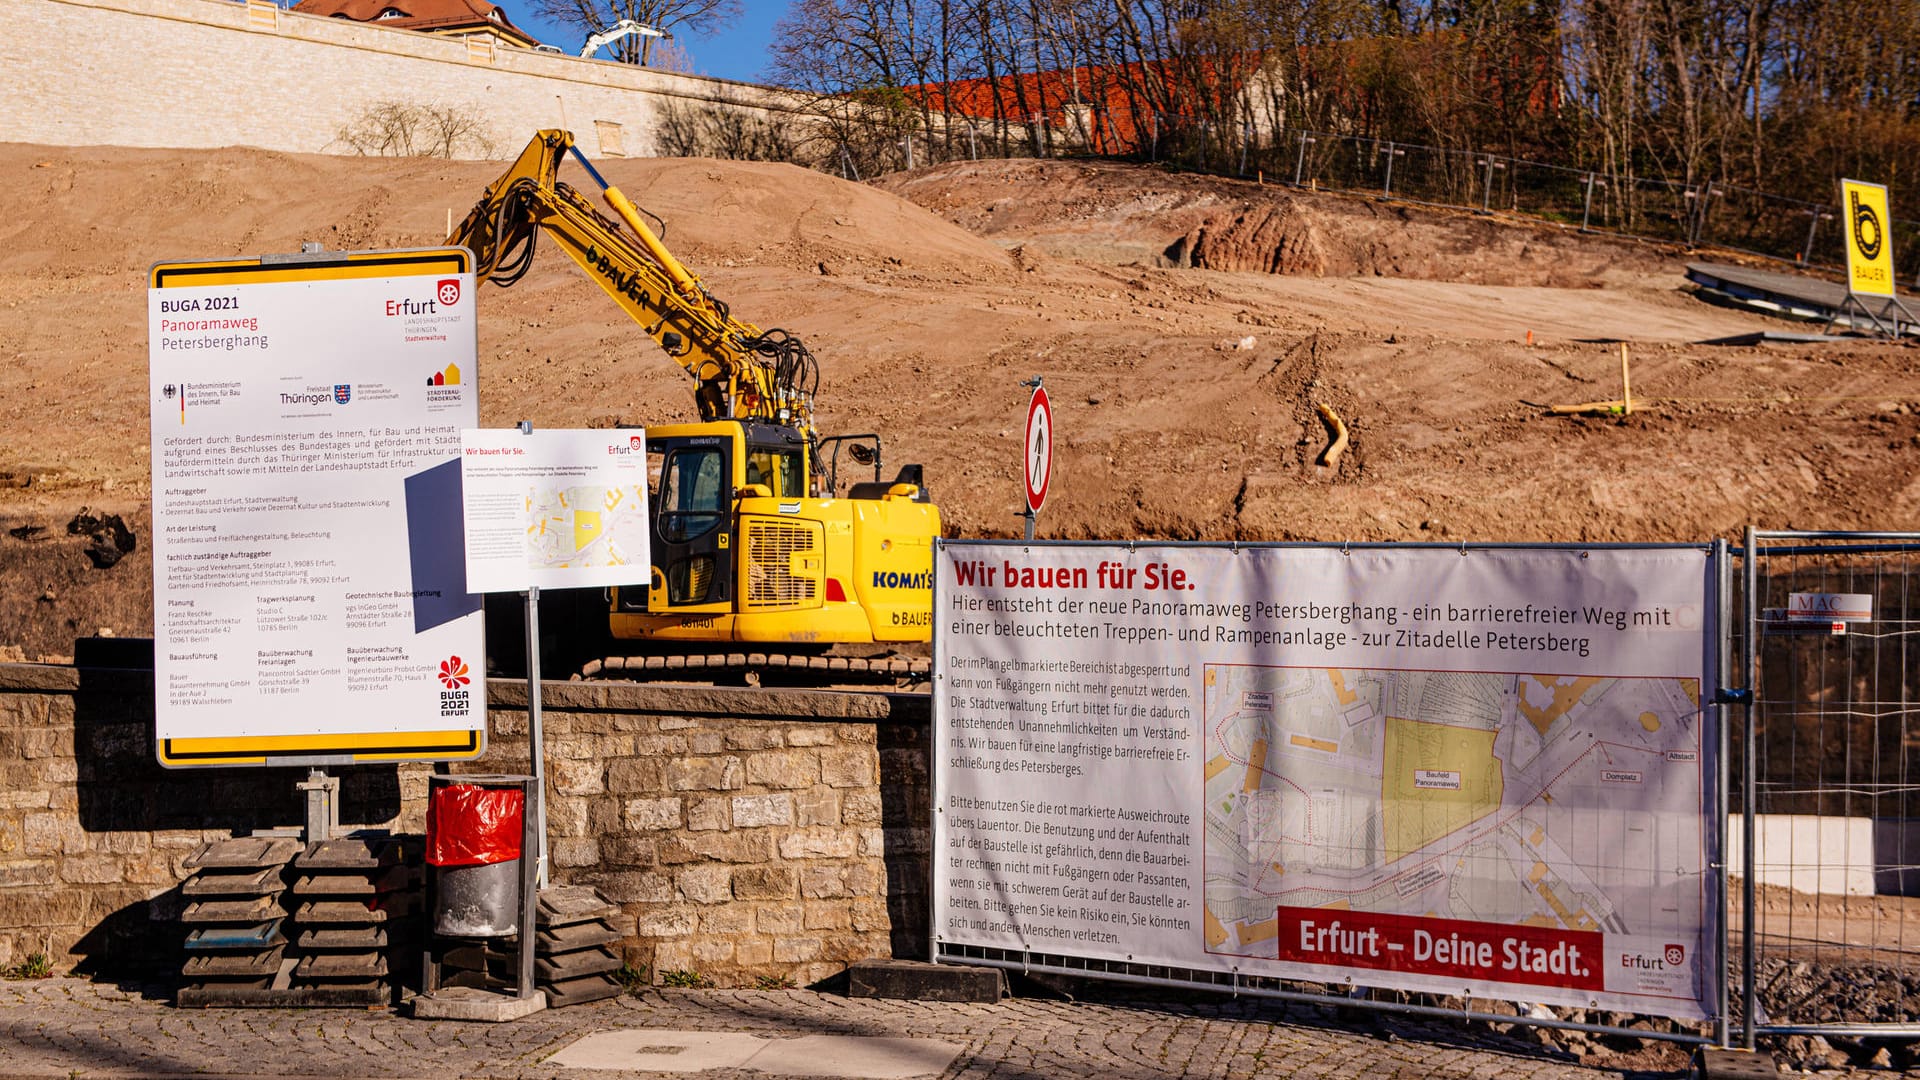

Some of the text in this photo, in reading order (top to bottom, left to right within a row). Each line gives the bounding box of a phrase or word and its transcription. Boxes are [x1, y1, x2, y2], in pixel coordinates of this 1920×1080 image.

[1855, 265, 1885, 281] BAUER
[597, 255, 650, 311] BAUER
[161, 296, 239, 313] BUGA 2021
[386, 298, 436, 316] Erfurt
[162, 318, 258, 332] Panoramaweg
[162, 334, 268, 351] Petersberghang
[405, 334, 446, 342] Stadtverwaltung
[187, 382, 241, 390] Bundesministerium
[280, 393, 331, 405] Thüringen
[164, 425, 455, 446] Gefördert durch: Bundesministerium des Innern, für Bau und Heimat
[501, 447, 511, 455] für
[608, 445, 630, 455] Erfurt
[165, 459, 416, 478] Landwirtschaft sowie mit Mitteln der Landeshauptstadt Erfurt.
[165, 488, 207, 496] Auftraggeber
[189, 525, 216, 533] Leistung
[873, 569, 933, 589] KOMATS
[953, 559, 1195, 591] Wir bauen für Sie.
[953, 594, 983, 611] Hier
[987, 596, 1053, 613] entsteht
[1058, 596, 1084, 613] der
[1089, 601, 1127, 614] neue
[1132, 598, 1251, 622] Panoramaweg
[1256, 601, 1397, 625] Petersberghang
[1413, 604, 1441, 621] ein
[1448, 603, 1577, 624] barrierefreier
[1583, 607, 1627, 629] Weg
[1634, 607, 1671, 625] mit
[1798, 596, 1842, 610] MAC
[902, 612, 932, 625] BAUER
[952, 618, 990, 635] einer
[994, 619, 1099, 638] beleuchteten
[1103, 623, 1173, 644] Treppen-
[1178, 625, 1209, 642] und
[1216, 626, 1346, 650] Rampenanlage
[1362, 633, 1391, 646] zur
[1396, 630, 1480, 648] Zitadelle
[1487, 631, 1589, 657] Petersberg
[950, 675, 1190, 698] kann von Fußgängern nicht mehr genutzt werden.
[441, 691, 468, 700] BUGA
[441, 700, 469, 709] 2021
[950, 695, 1190, 719] Die Stadtverwaltung Erfurt bittet für die dadurch
[950, 716, 1190, 740] entstehenden Unannehmlichkeiten um Verständ-
[950, 735, 1190, 761] nis. Wir bauen für eine langfristige barrierefreie Er-
[1669, 752, 1696, 761] Altstadt
[950, 756, 1084, 778] schließung des Petersberges.
[1426, 771, 1449, 779] Baufeld
[1415, 779, 1459, 788] Panoramaweg
[1605, 772, 1637, 781] Domplatz
[950, 795, 1190, 825] Bitte benutzen Sie die rot markierte Ausweichroute
[950, 815, 1190, 846] übers Lauentor. Die Benutzung und der Aufenthalt
[950, 836, 1190, 866] auf der Baustelle ist gefährlich, denn die Bauarbei-
[950, 856, 1190, 890] ter rechnen nicht mit Fußgängern oder Passanten,
[1299, 919, 1379, 957] Erfurt
[1413, 929, 1494, 968] Deine
[1502, 938, 1590, 978] Stadt.
[1622, 953, 1663, 970] Erfurt
